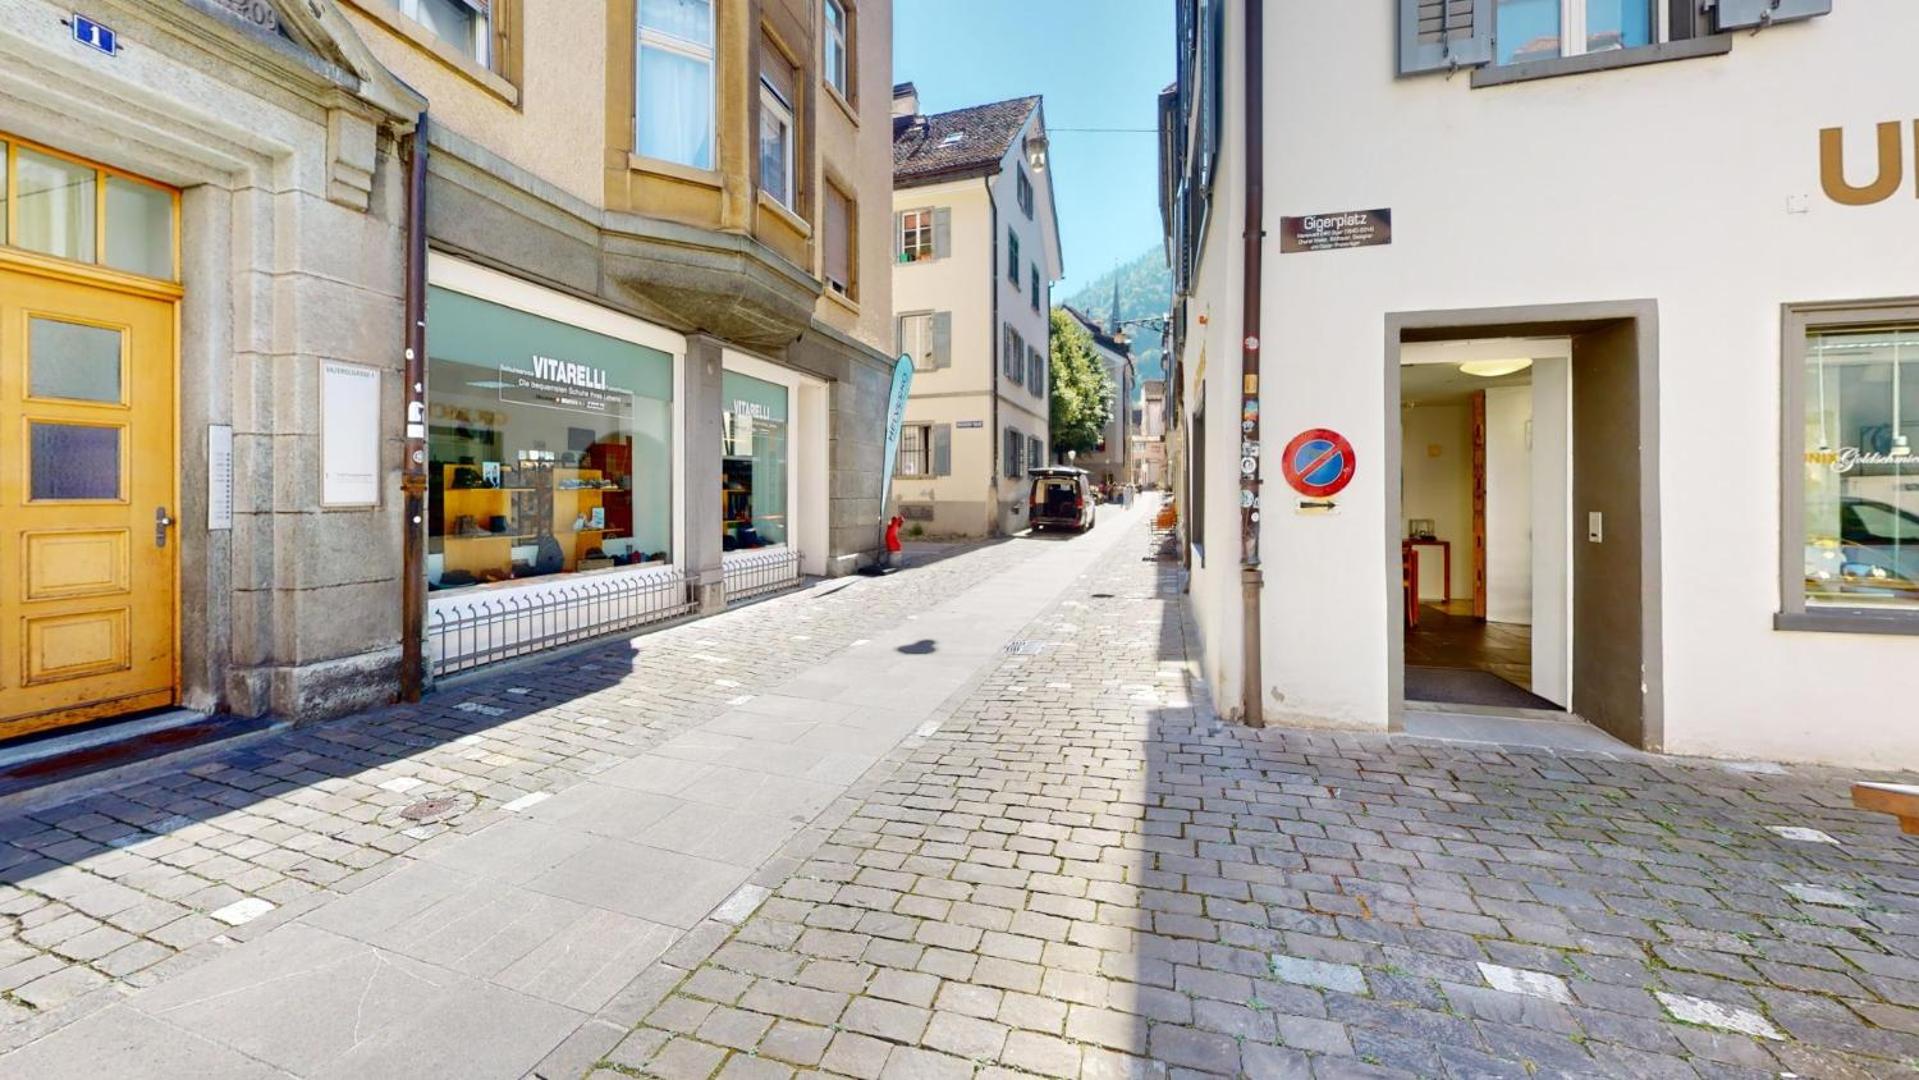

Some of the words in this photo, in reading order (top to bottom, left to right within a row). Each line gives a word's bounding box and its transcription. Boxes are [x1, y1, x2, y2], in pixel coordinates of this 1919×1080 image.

[90, 26, 102, 47] 1
[1304, 214, 1367, 232] Gigerplatz
[533, 355, 606, 390] VITARELLI
[518, 378, 530, 388] Die
[734, 400, 770, 420] VITARELLI
